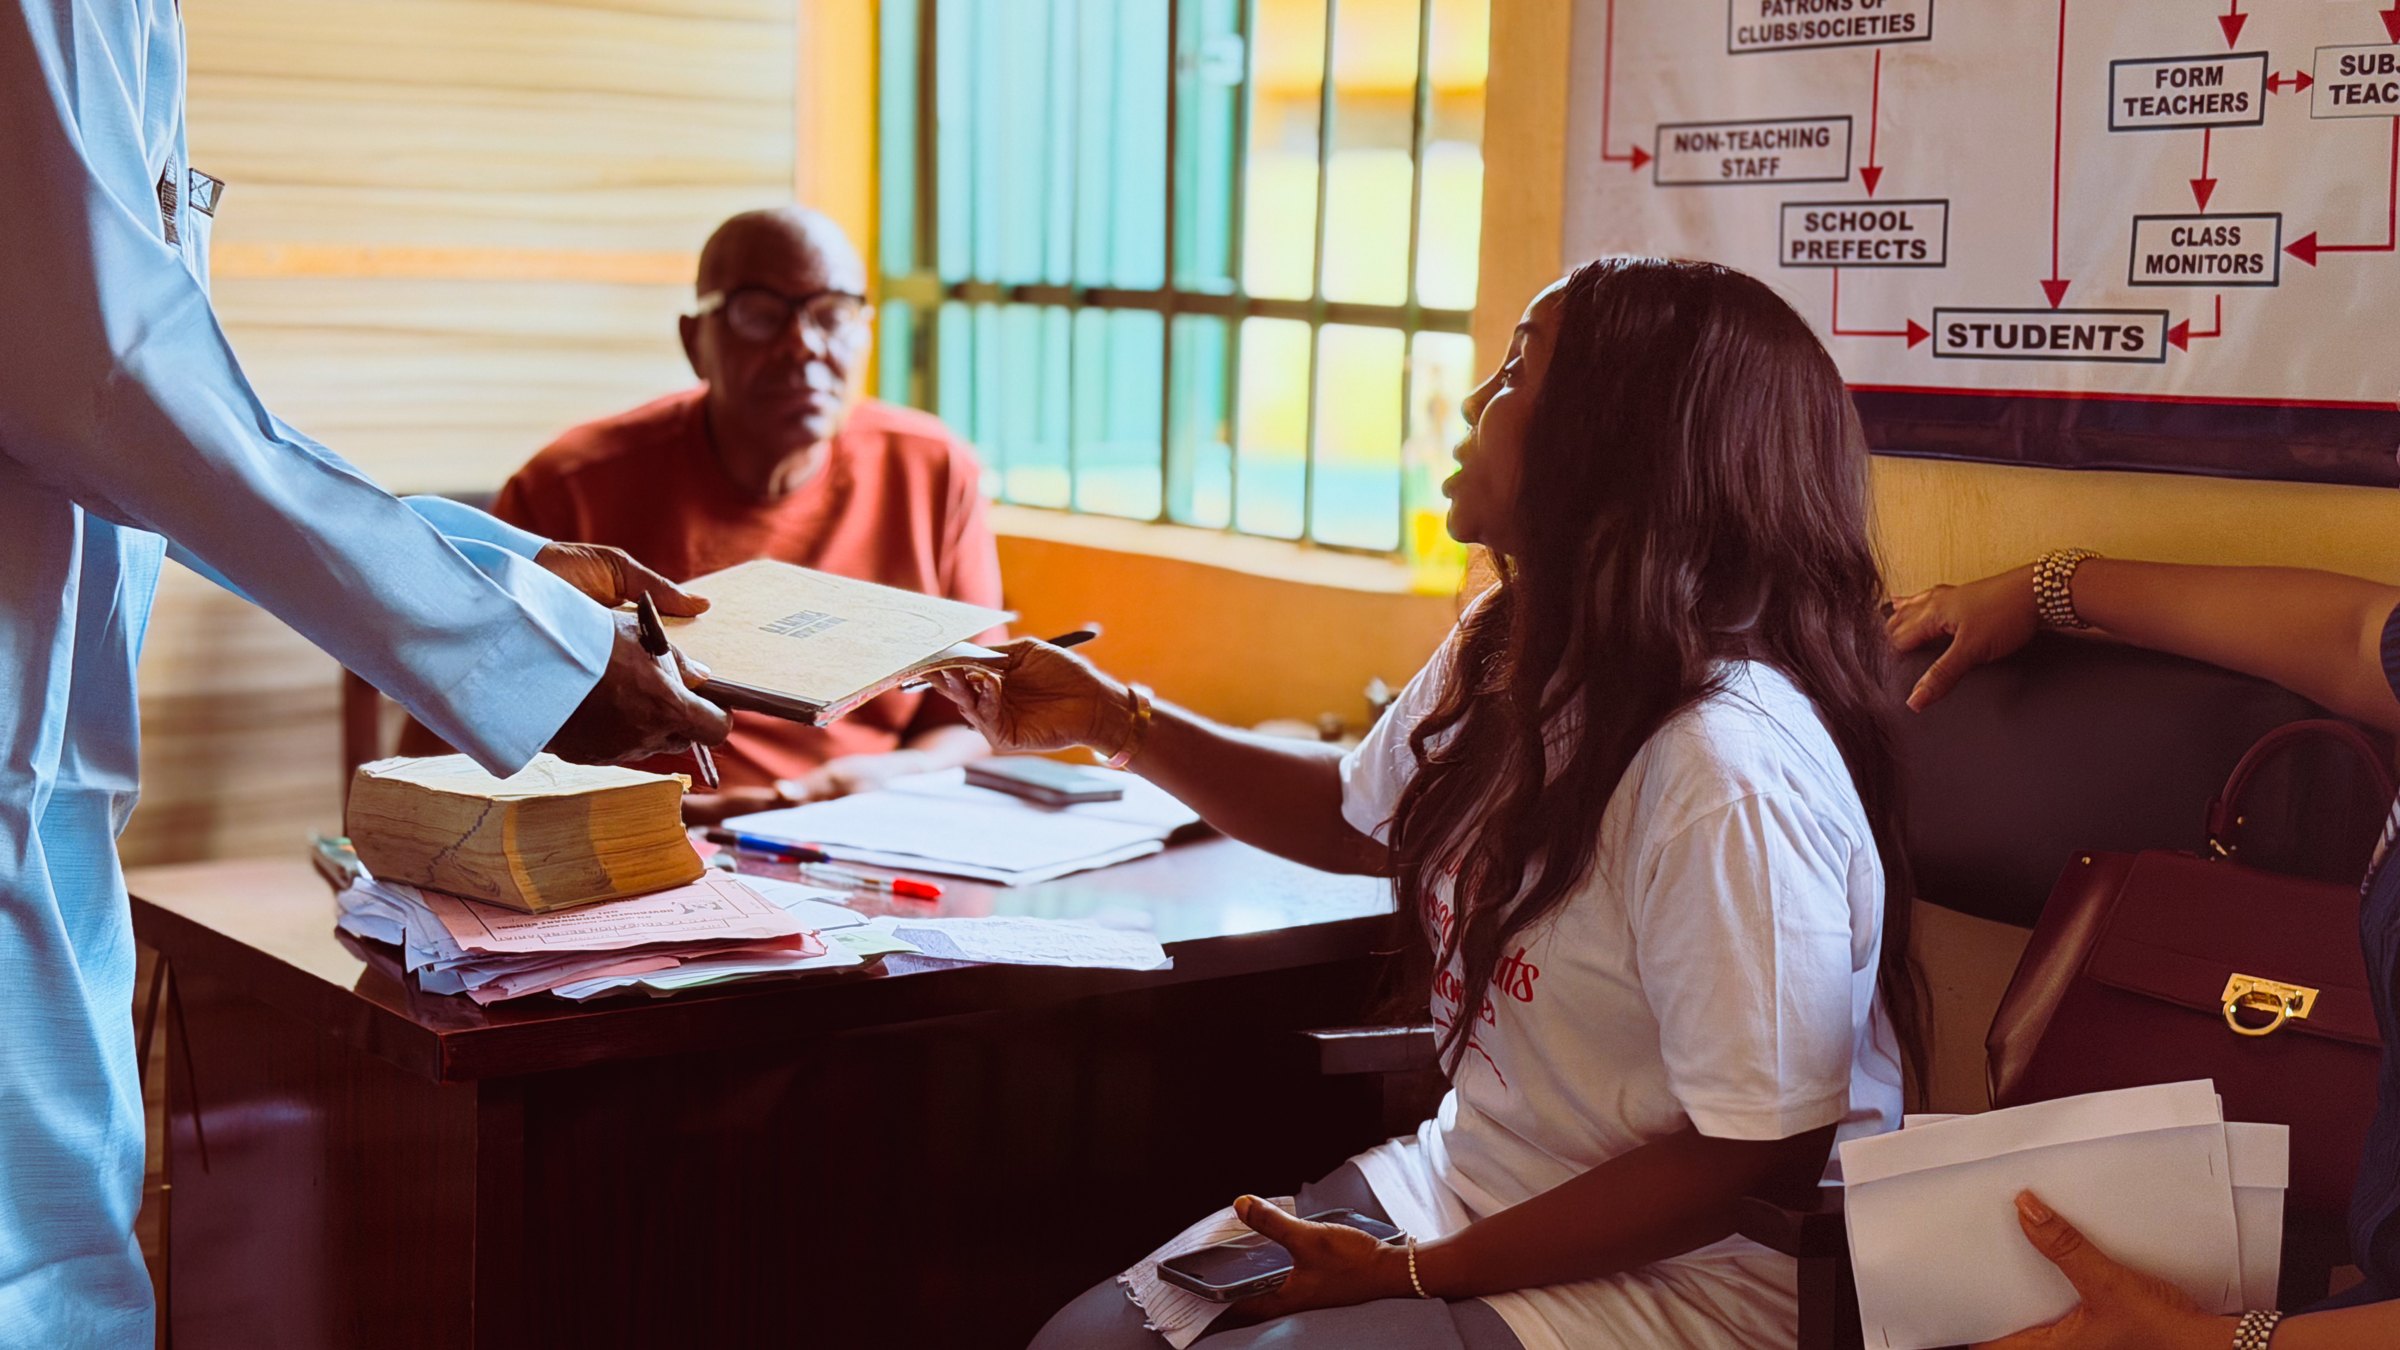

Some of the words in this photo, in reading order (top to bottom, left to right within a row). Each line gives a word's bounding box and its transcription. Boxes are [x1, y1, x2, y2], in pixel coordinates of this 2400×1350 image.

[1761, 0, 1852, 18] PATRONS
[1738, 13, 1916, 44] CLUBS/SOCIETIES
[2340, 53, 2400, 76] SUB
[2155, 66, 2224, 89] FORM
[2123, 92, 2249, 117] TEACHERS
[1675, 127, 1831, 153] NON-TEACHING
[1721, 157, 1780, 178] STAFF
[1804, 211, 1914, 233] SCHOOL
[2171, 226, 2241, 247] CLASS
[1791, 239, 1927, 260] PREFECTS
[2145, 254, 2264, 275] MONITORS
[1947, 323, 2144, 352] STUDENTS
